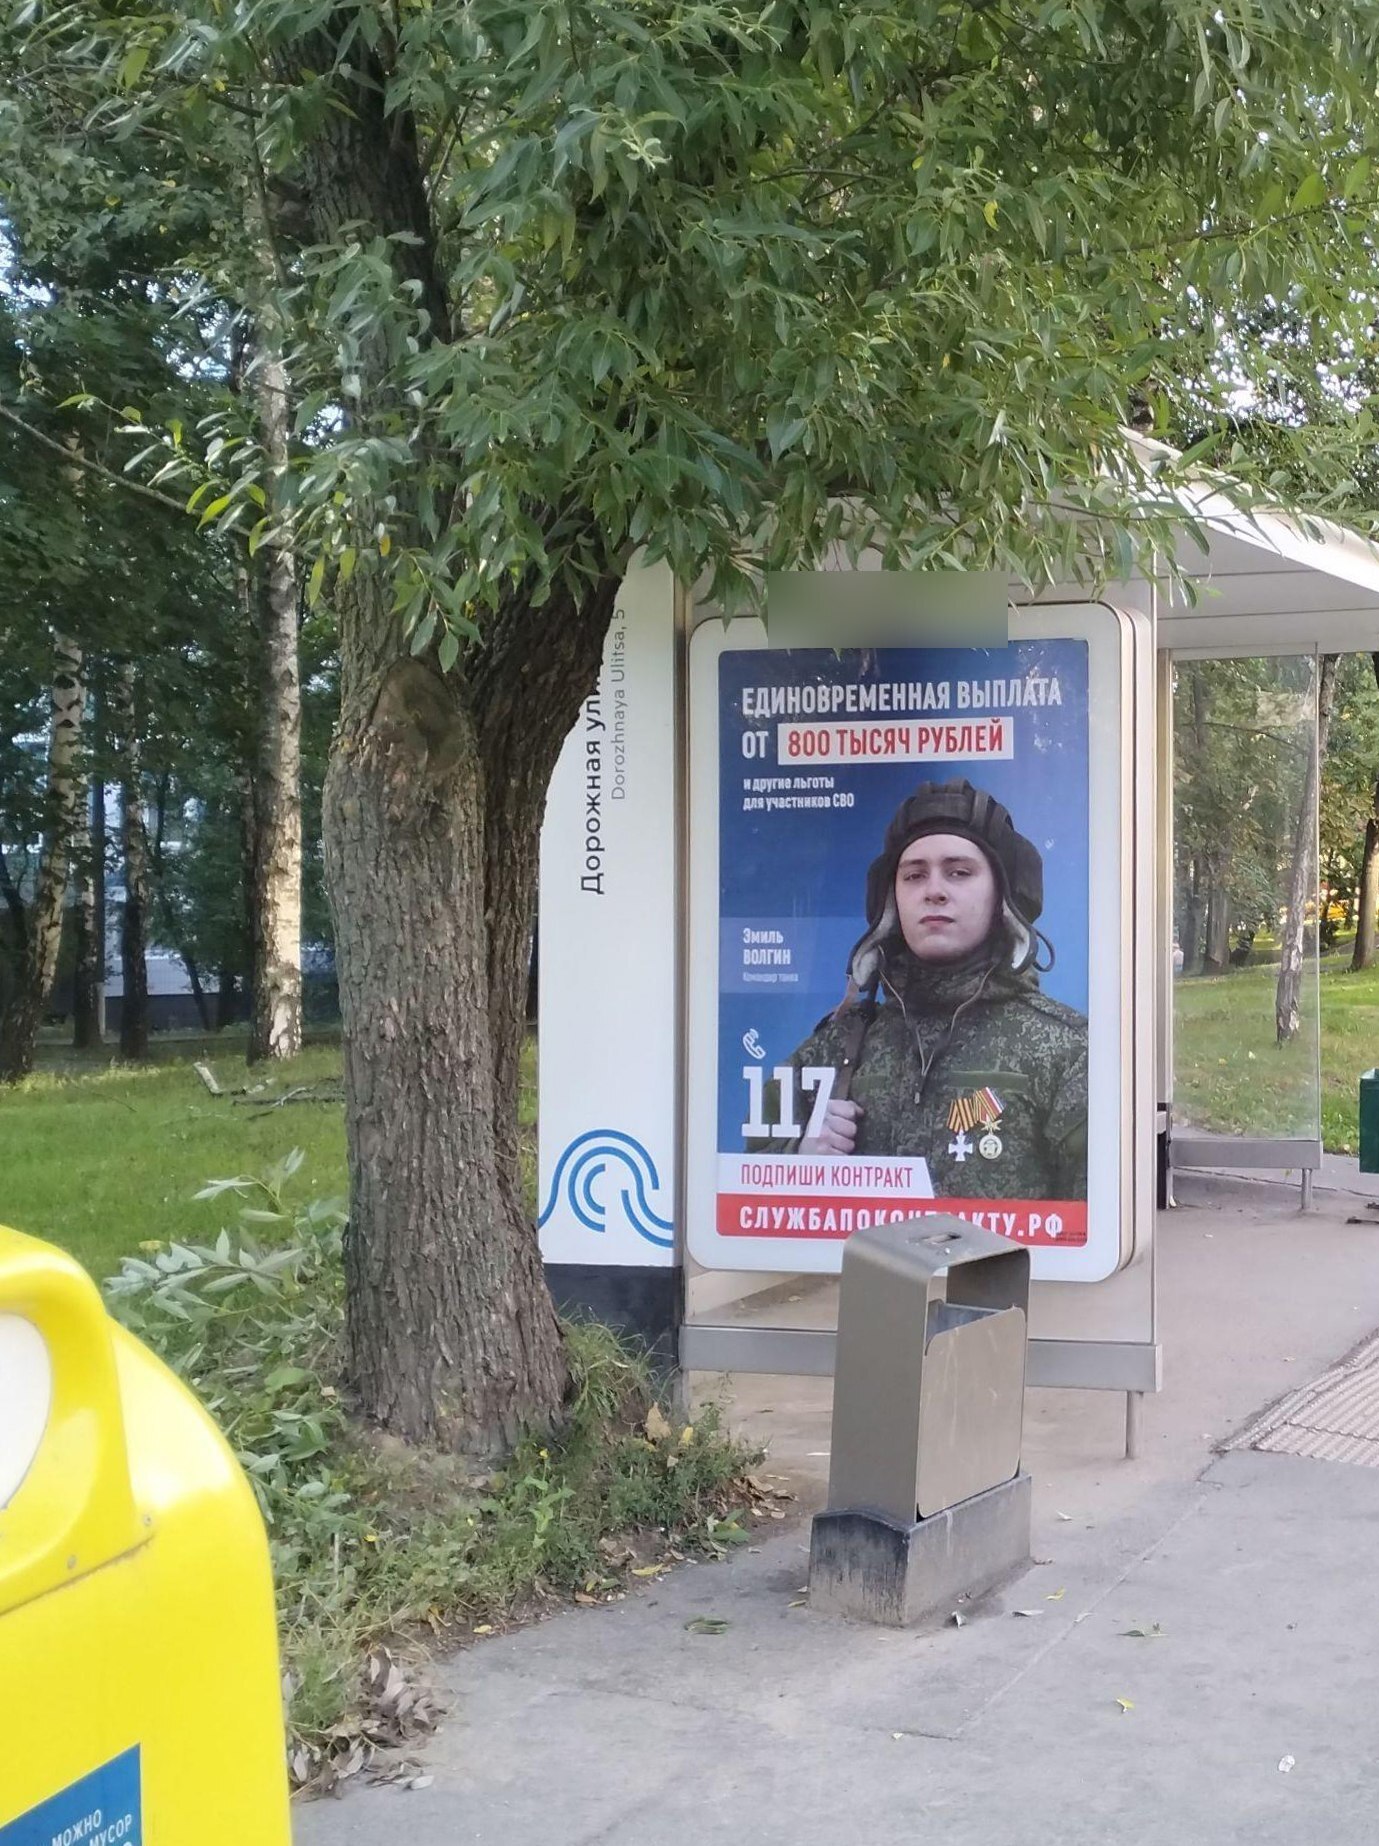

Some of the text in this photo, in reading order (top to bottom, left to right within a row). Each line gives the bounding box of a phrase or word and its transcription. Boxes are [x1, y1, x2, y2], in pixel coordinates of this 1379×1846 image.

[610, 626, 628, 682] Ulitsa,
[742, 678, 1062, 718] ЕДИНОВРЕМЕННАЯ ВЫПЛАТА
[611, 688, 629, 800] Dorozhnaya
[742, 719, 1003, 759] ОТ 800 ТЫСЯЧ РУБЛЕЙ
[743, 777, 834, 793] и другие льготы
[743, 793, 854, 812] для участников СВО
[581, 740, 605, 895] Дорожная
[743, 928, 784, 944] Эмиль
[743, 949, 791, 965] ВОЛГИН
[742, 1067, 835, 1138] 117
[741, 1164, 913, 1189] ПОДПИШИ КОНТРАКТ
[52, 1809, 102, 1846] МОЖНО
[89, 1814, 132, 1846] МУСОР
